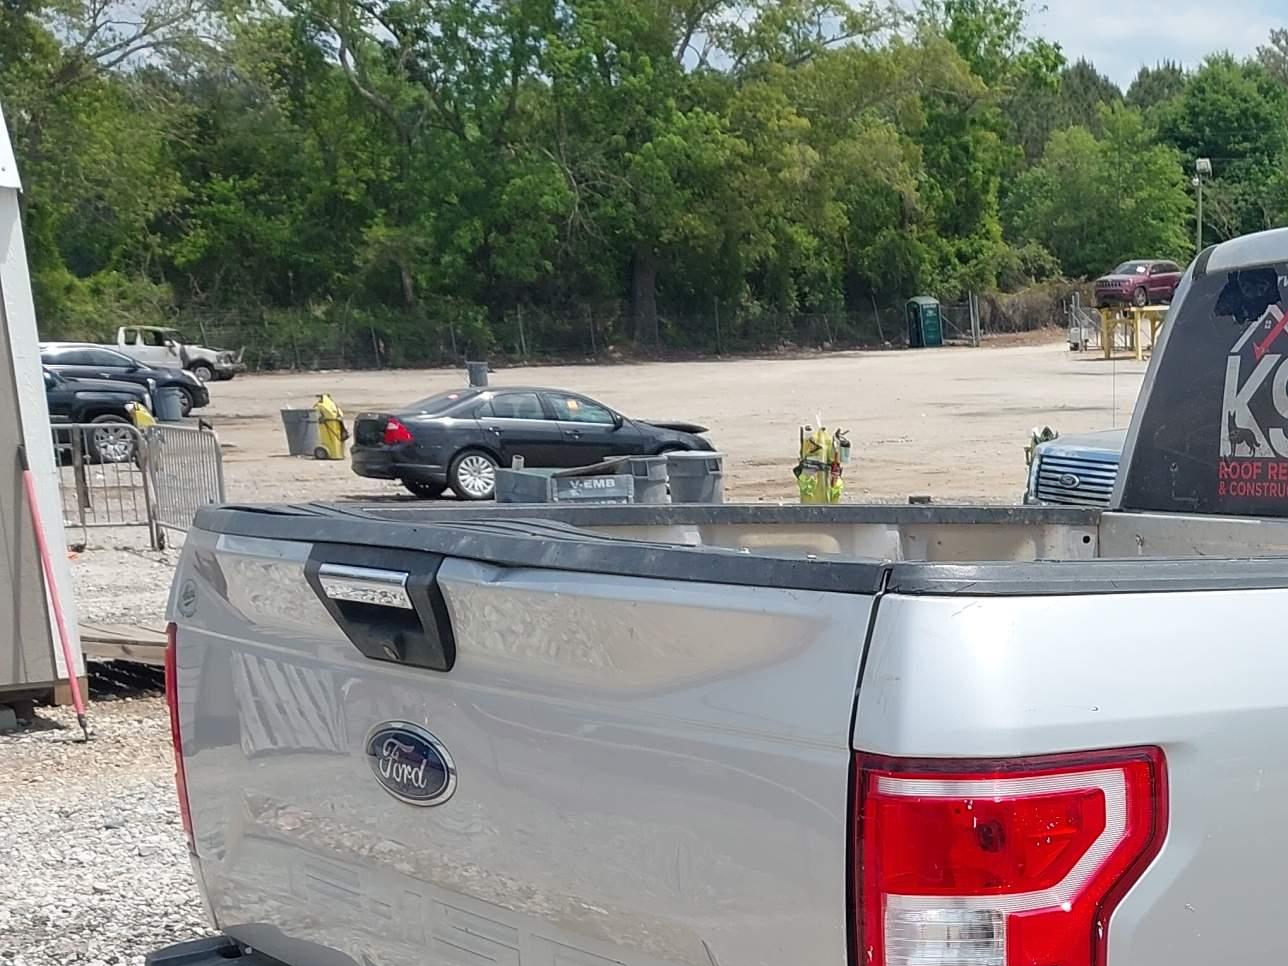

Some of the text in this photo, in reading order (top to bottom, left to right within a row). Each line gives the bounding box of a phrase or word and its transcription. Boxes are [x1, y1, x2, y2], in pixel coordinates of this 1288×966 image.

[1218, 461, 1262, 480] ROOF
[1218, 481, 1226, 496] &
[379, 738, 428, 789] Ford
